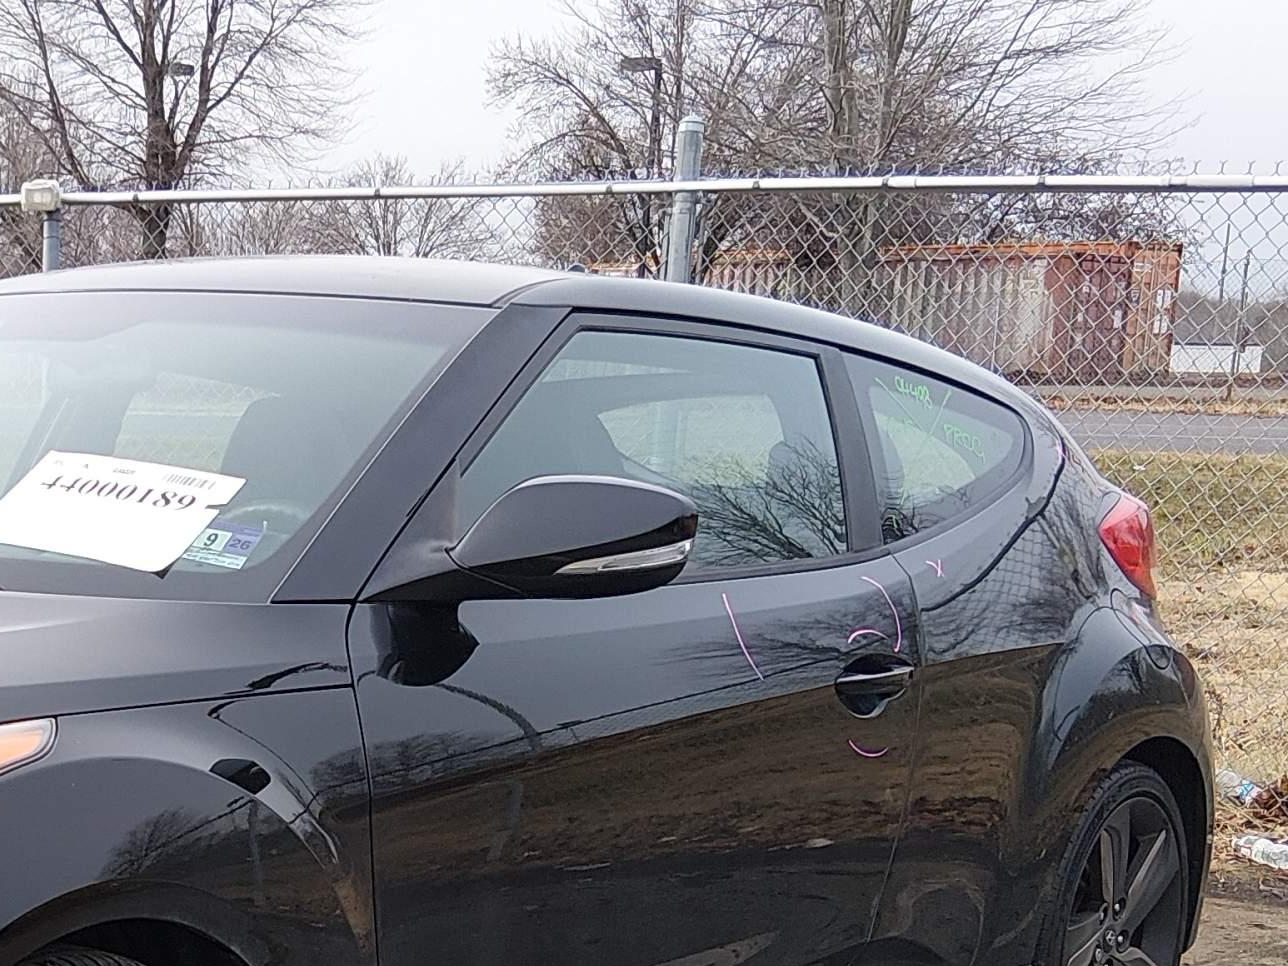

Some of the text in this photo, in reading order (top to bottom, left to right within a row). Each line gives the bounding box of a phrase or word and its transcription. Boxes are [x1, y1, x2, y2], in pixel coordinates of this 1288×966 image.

[40, 474, 197, 511] 44000189
[203, 532, 252, 550] 9 26
